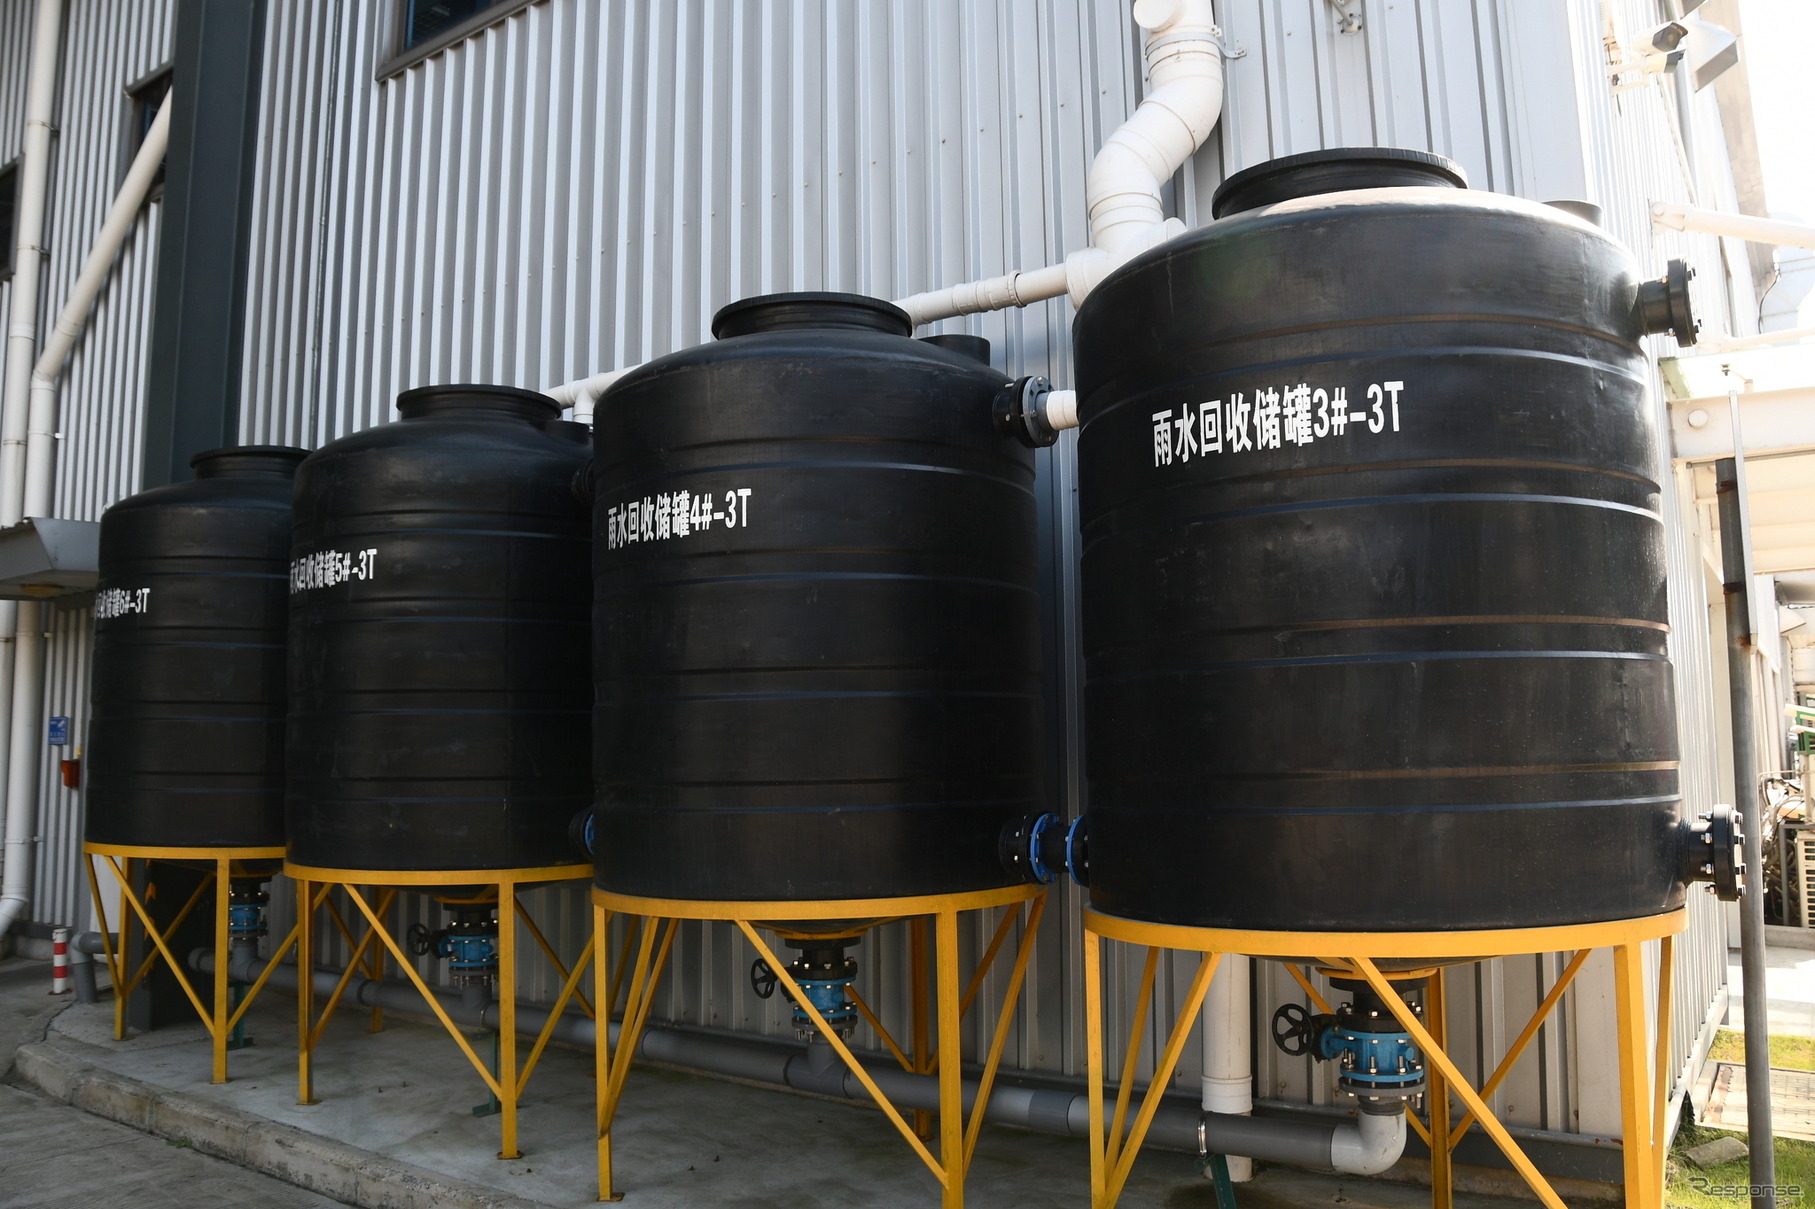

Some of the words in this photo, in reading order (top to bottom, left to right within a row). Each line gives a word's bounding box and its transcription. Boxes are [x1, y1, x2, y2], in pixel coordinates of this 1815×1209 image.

[1152, 381, 1404, 467] 雨水回收储罐3#-3T
[608, 488, 751, 550] 雨水回收储罐4#-3T
